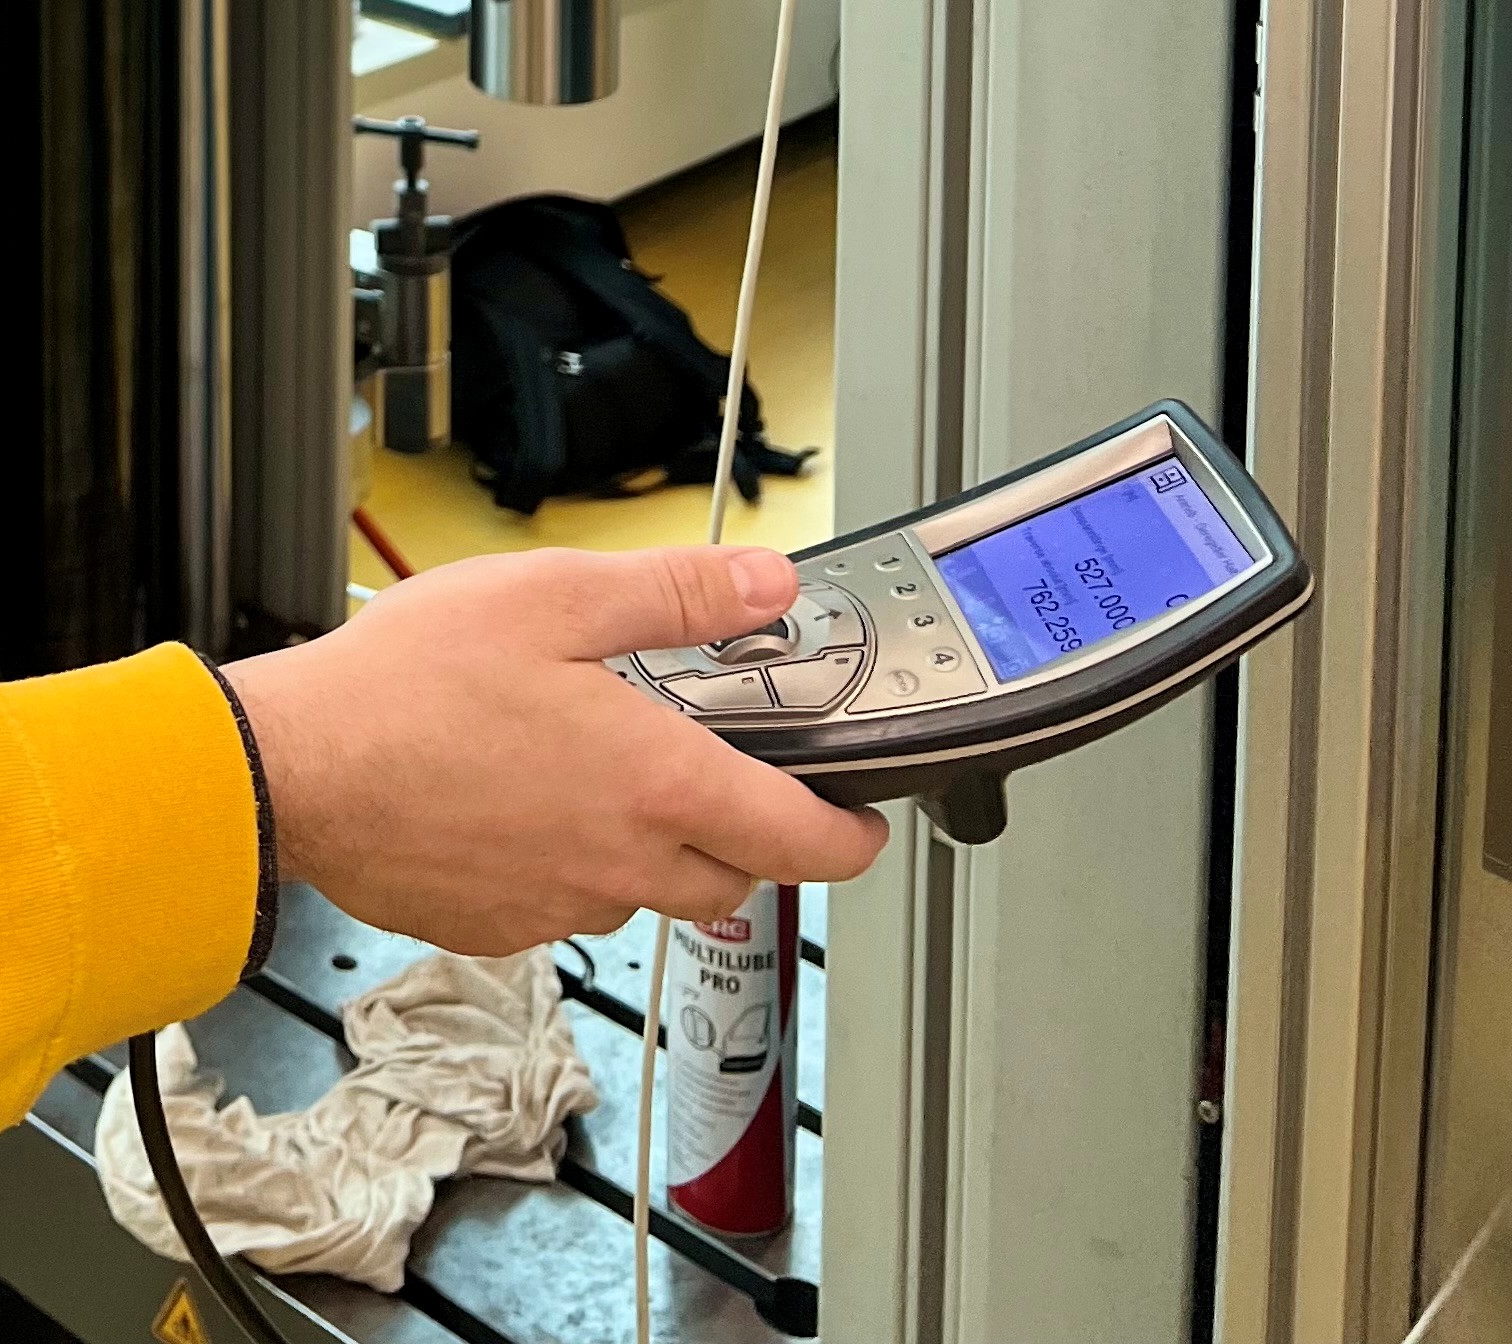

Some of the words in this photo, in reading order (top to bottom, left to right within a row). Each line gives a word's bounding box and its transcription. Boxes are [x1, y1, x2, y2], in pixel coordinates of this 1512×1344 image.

[881, 556, 900, 566] 1
[895, 583, 917, 595] 2
[1074, 557, 1136, 630] 527.000
[913, 614, 934, 627] 3
[1022, 578, 1084, 652] 762.259
[934, 653, 955, 665] 4
[674, 926, 776, 971] MULTILUBE
[700, 969, 741, 994] PRO
